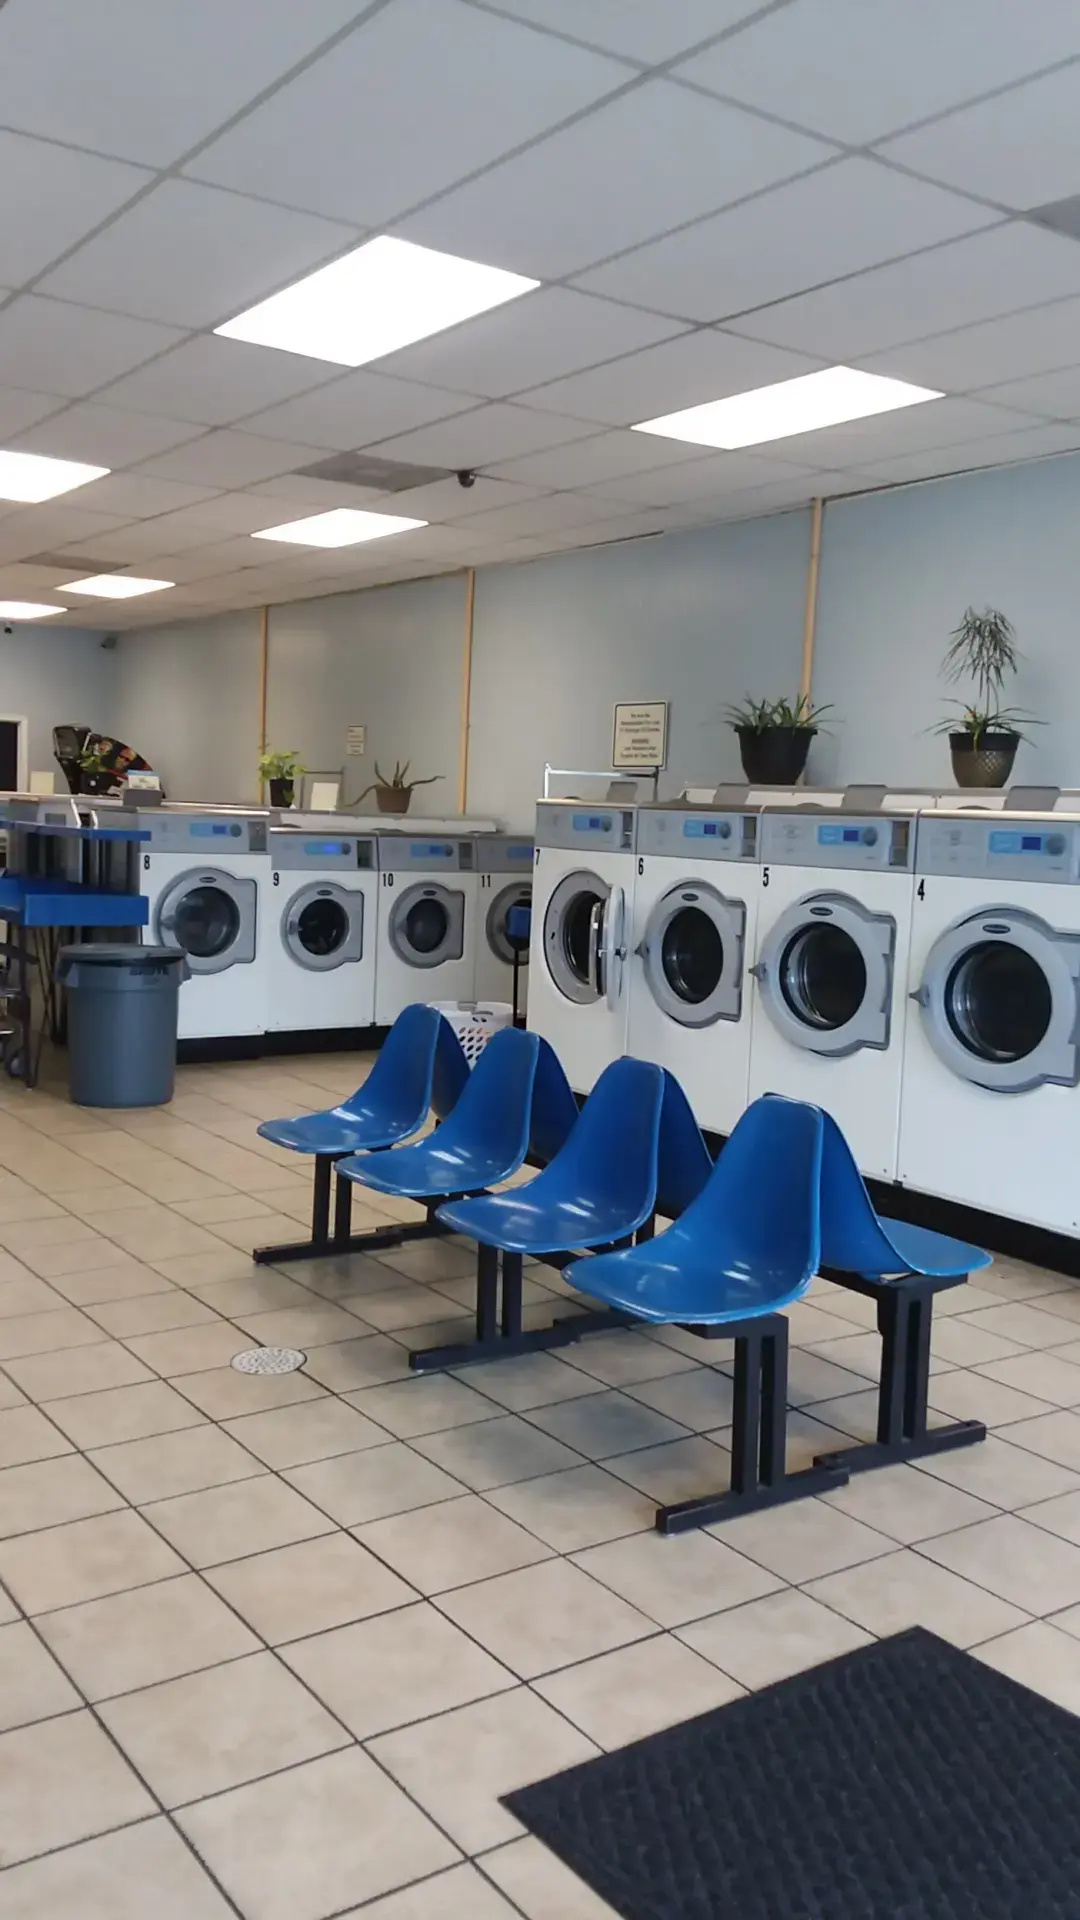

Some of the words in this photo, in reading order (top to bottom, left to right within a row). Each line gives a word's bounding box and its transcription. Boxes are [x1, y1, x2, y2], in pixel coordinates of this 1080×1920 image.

[144, 854, 150, 870] 8
[535, 849, 541, 865] 7
[638, 857, 644, 876] 6
[273, 872, 280, 887] 9
[383, 873, 394, 887] 10
[481, 874, 491, 888] 11
[762, 866, 770, 888] 5
[917, 879, 925, 901] 4
